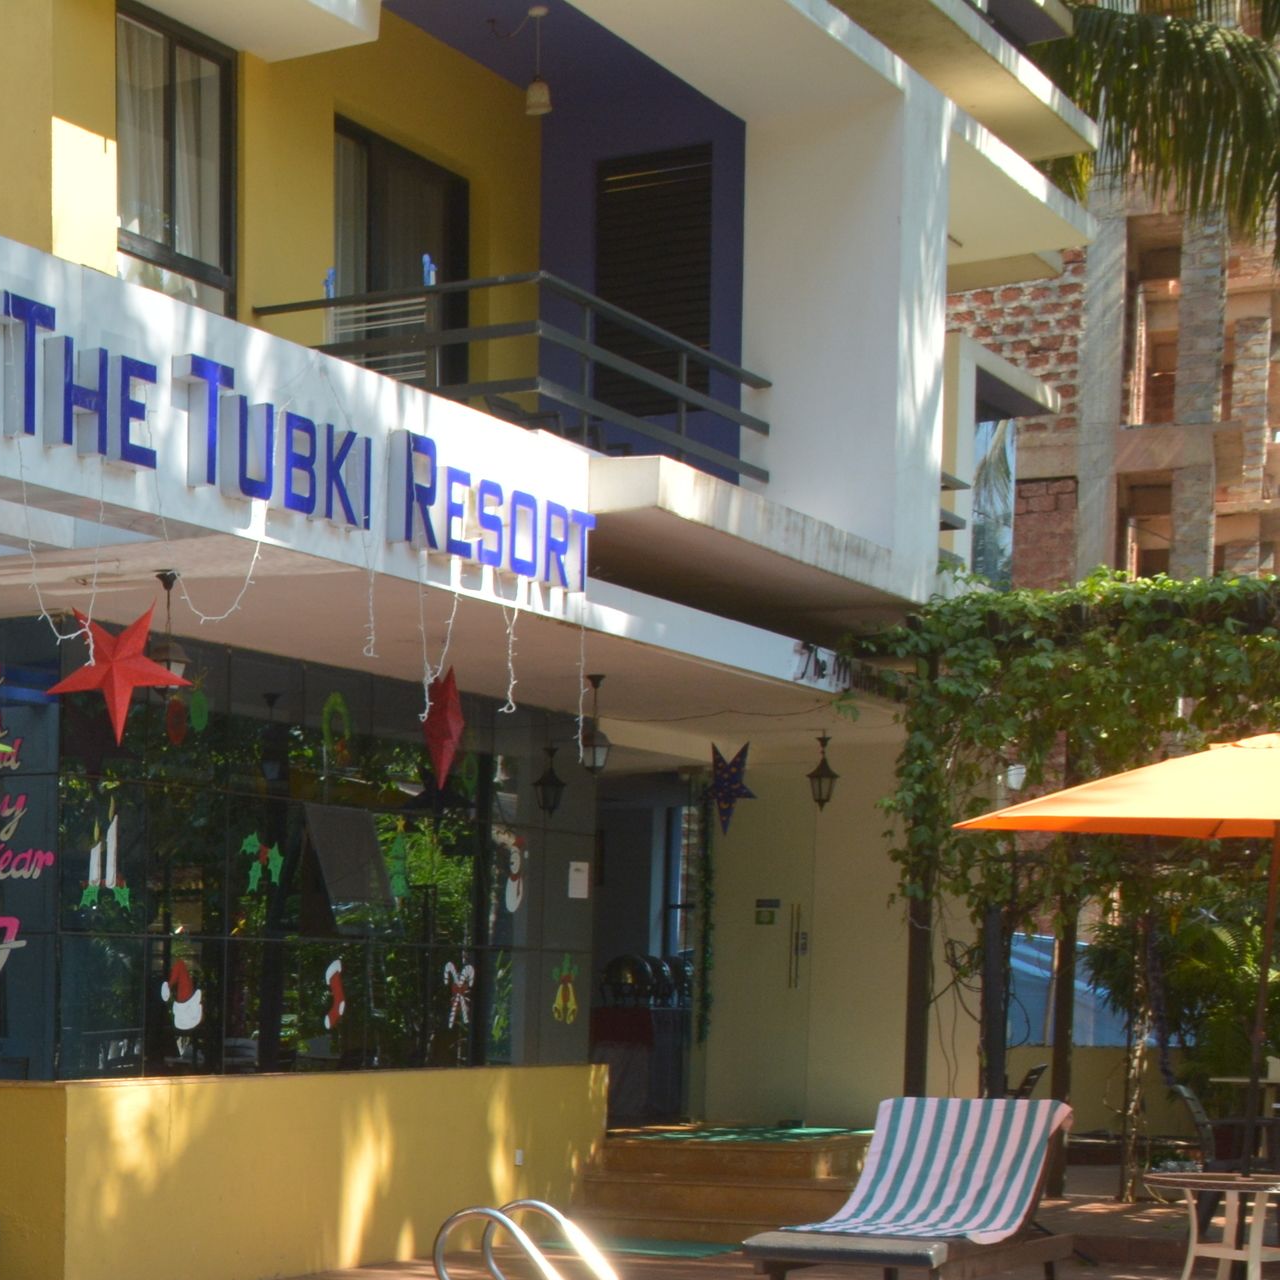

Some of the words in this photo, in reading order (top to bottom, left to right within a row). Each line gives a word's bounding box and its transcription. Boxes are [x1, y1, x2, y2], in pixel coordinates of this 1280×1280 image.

[0, 290, 157, 470] THE
[187, 353, 372, 531] TUBKI
[403, 428, 596, 592] RESORT
